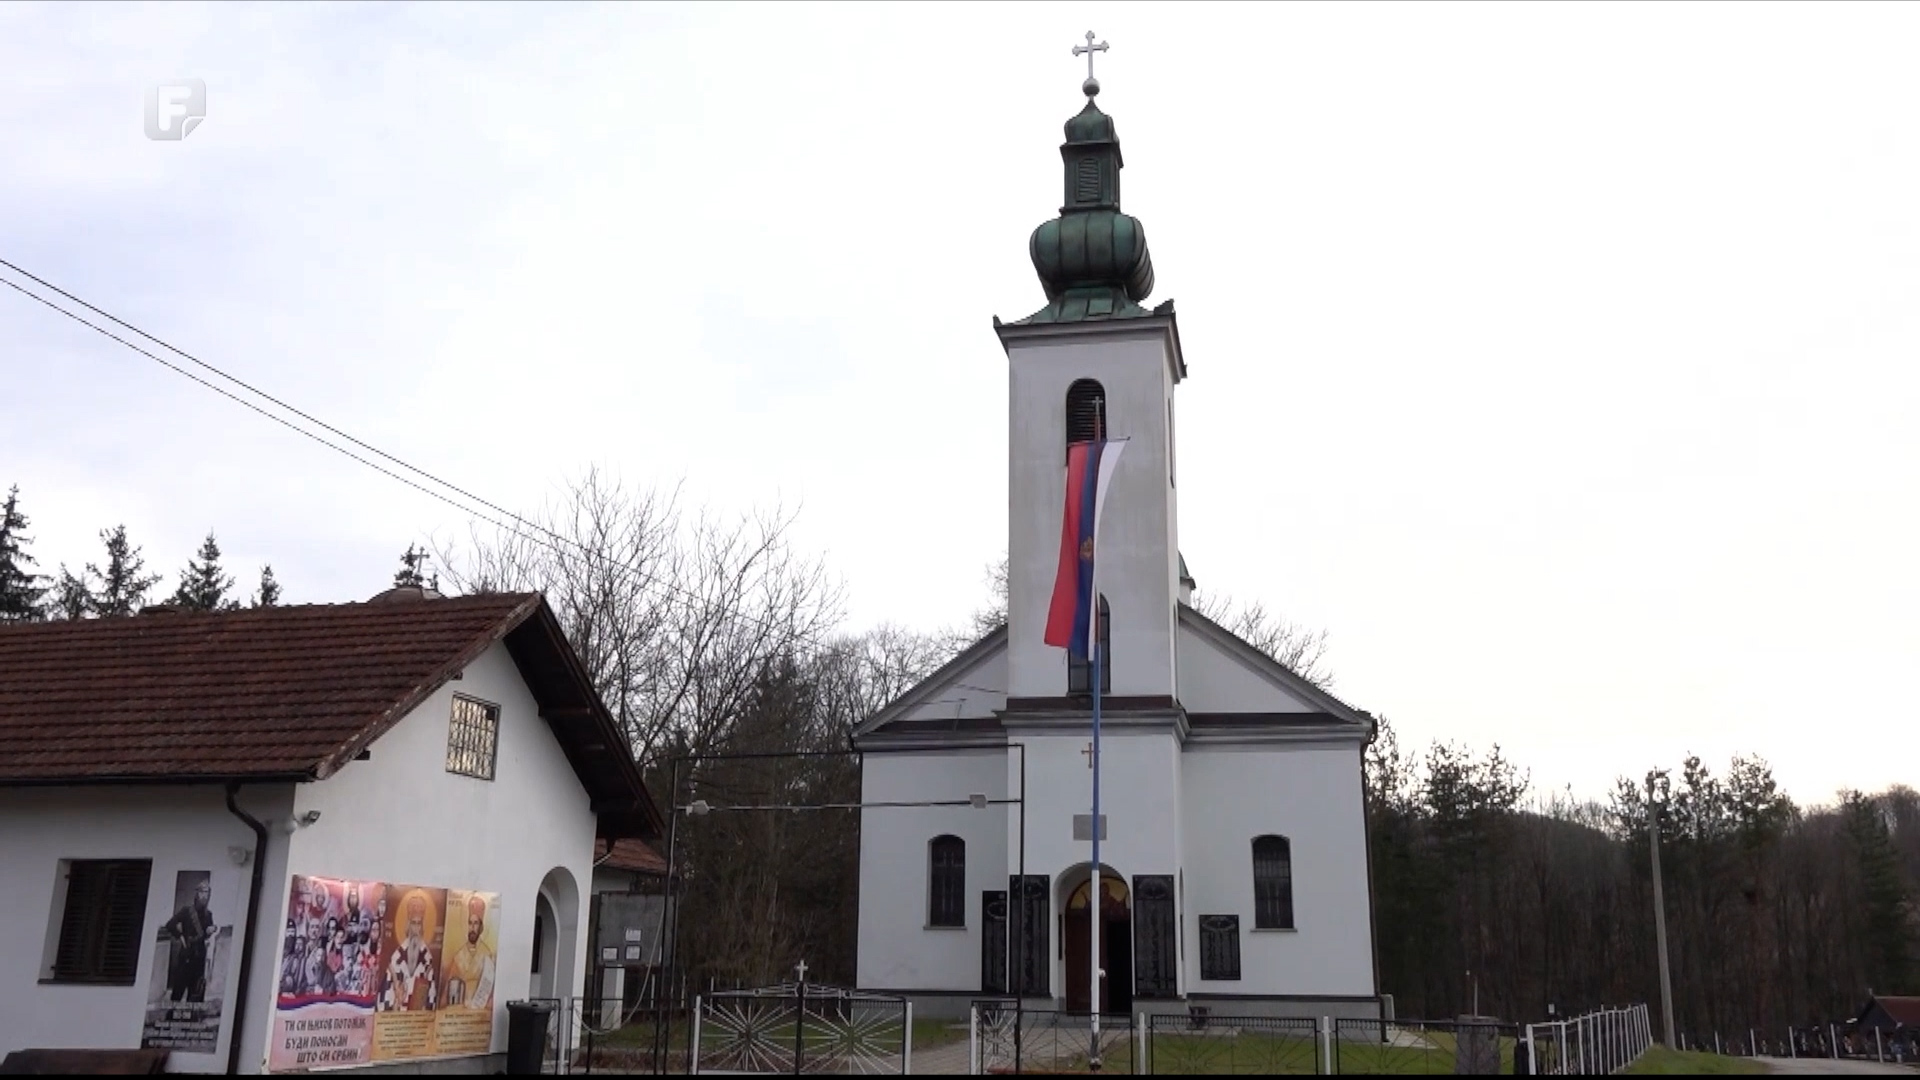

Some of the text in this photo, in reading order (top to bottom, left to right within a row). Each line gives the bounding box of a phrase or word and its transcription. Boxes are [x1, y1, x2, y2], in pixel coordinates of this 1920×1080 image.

[285, 1017, 367, 1031] ТИ СИ ЊИХОВ ПОТОМАК
[285, 1034, 349, 1050] БУДИ ПОНОСАН
[297, 1051, 318, 1063] ШТО
[319, 1050, 332, 1061] СИ
